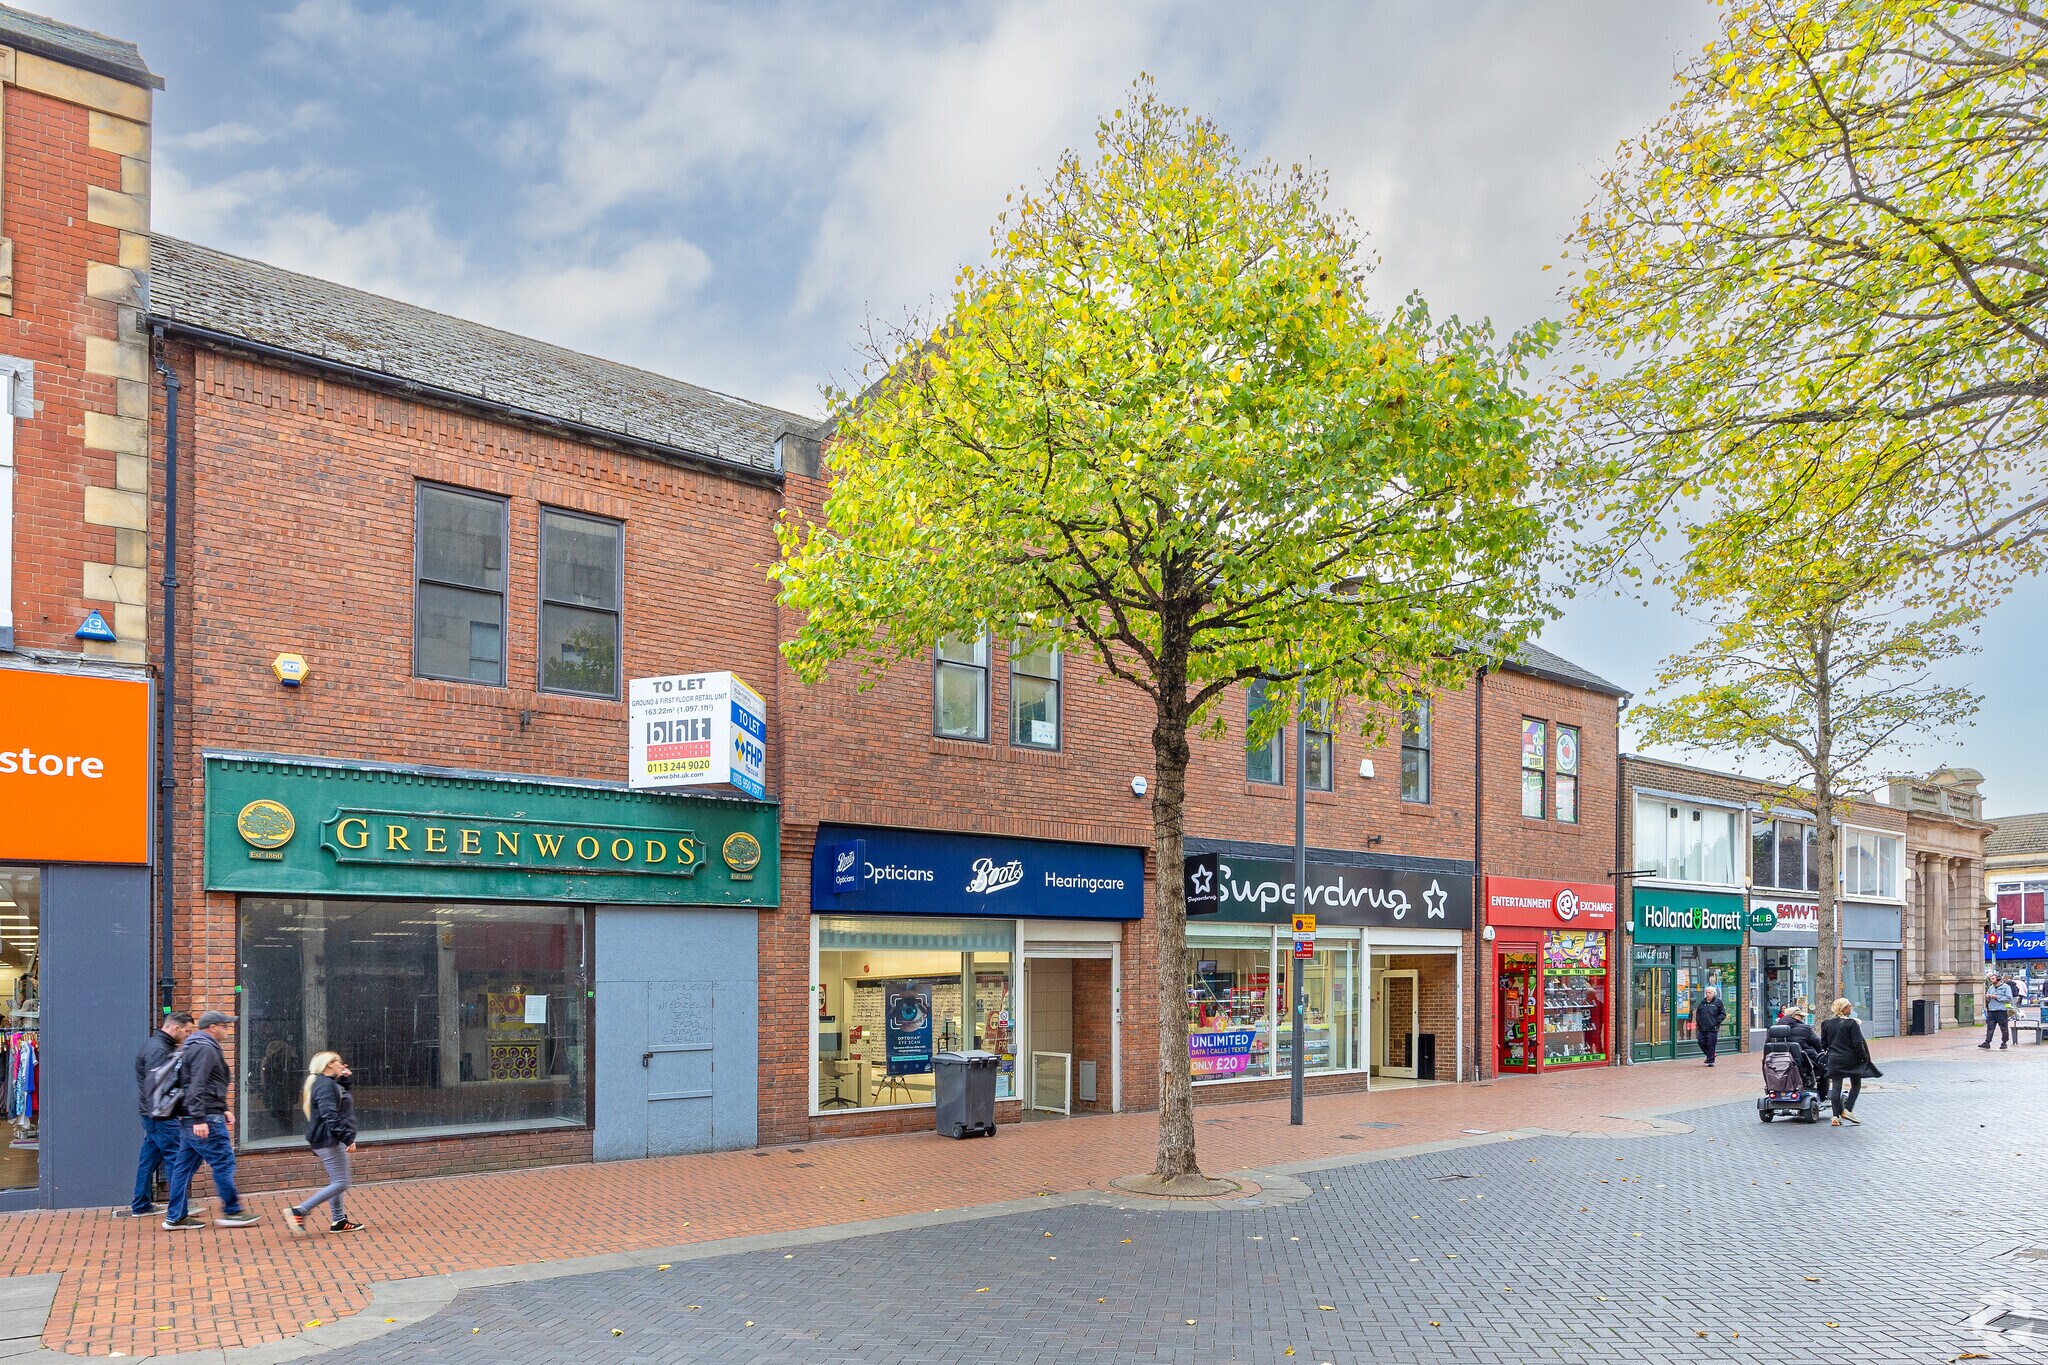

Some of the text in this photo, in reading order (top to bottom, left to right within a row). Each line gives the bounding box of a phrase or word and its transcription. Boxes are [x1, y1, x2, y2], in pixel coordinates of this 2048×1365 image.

[84, 627, 107, 635] Chubb
[284, 662, 299, 671] ADT
[652, 678, 706, 693] TO LET
[632, 699, 654, 707] GROUND
[660, 697, 675, 705] FIRST
[675, 695, 694, 704] FLOOR
[694, 693, 714, 702] RETAIL
[714, 692, 728, 700] UNIT
[738, 709, 760, 736] TO LET
[647, 718, 711, 744] bht
[648, 743, 710, 754] brackenridge
[690, 748, 710, 756] tate
[745, 740, 763, 769] FHP
[0, 748, 104, 779] store
[647, 759, 710, 773] 0113 244 9020
[653, 771, 704, 780] www.bht.uk.com
[733, 771, 763, 797] 0115 950 7577
[336, 818, 695, 865] GREENWOODS
[265, 852, 283, 860] 1860
[836, 851, 855, 873] Boots
[864, 861, 934, 884] Opticians
[965, 858, 1024, 895] Boots
[835, 875, 855, 886] Opticians
[1045, 872, 1124, 893] Hearingcare
[1187, 895, 1217, 903] Superdrug
[1491, 895, 1552, 909] ENTERTAINMENT
[1580, 901, 1613, 912] EXCHANGE
[1776, 903, 1810, 920] SAVVY
[1645, 905, 1693, 929] Holland
[1702, 908, 1741, 931] Barrett
[1776, 921, 1790, 929] Phone
[1794, 921, 1807, 930] Vapes
[1636, 951, 1669, 960] SINCE 1870
[677, 992, 692, 1001] DO
[1191, 1034, 1249, 1048] UNLIMITED
[1191, 1056, 1238, 1071] ONLY £20
